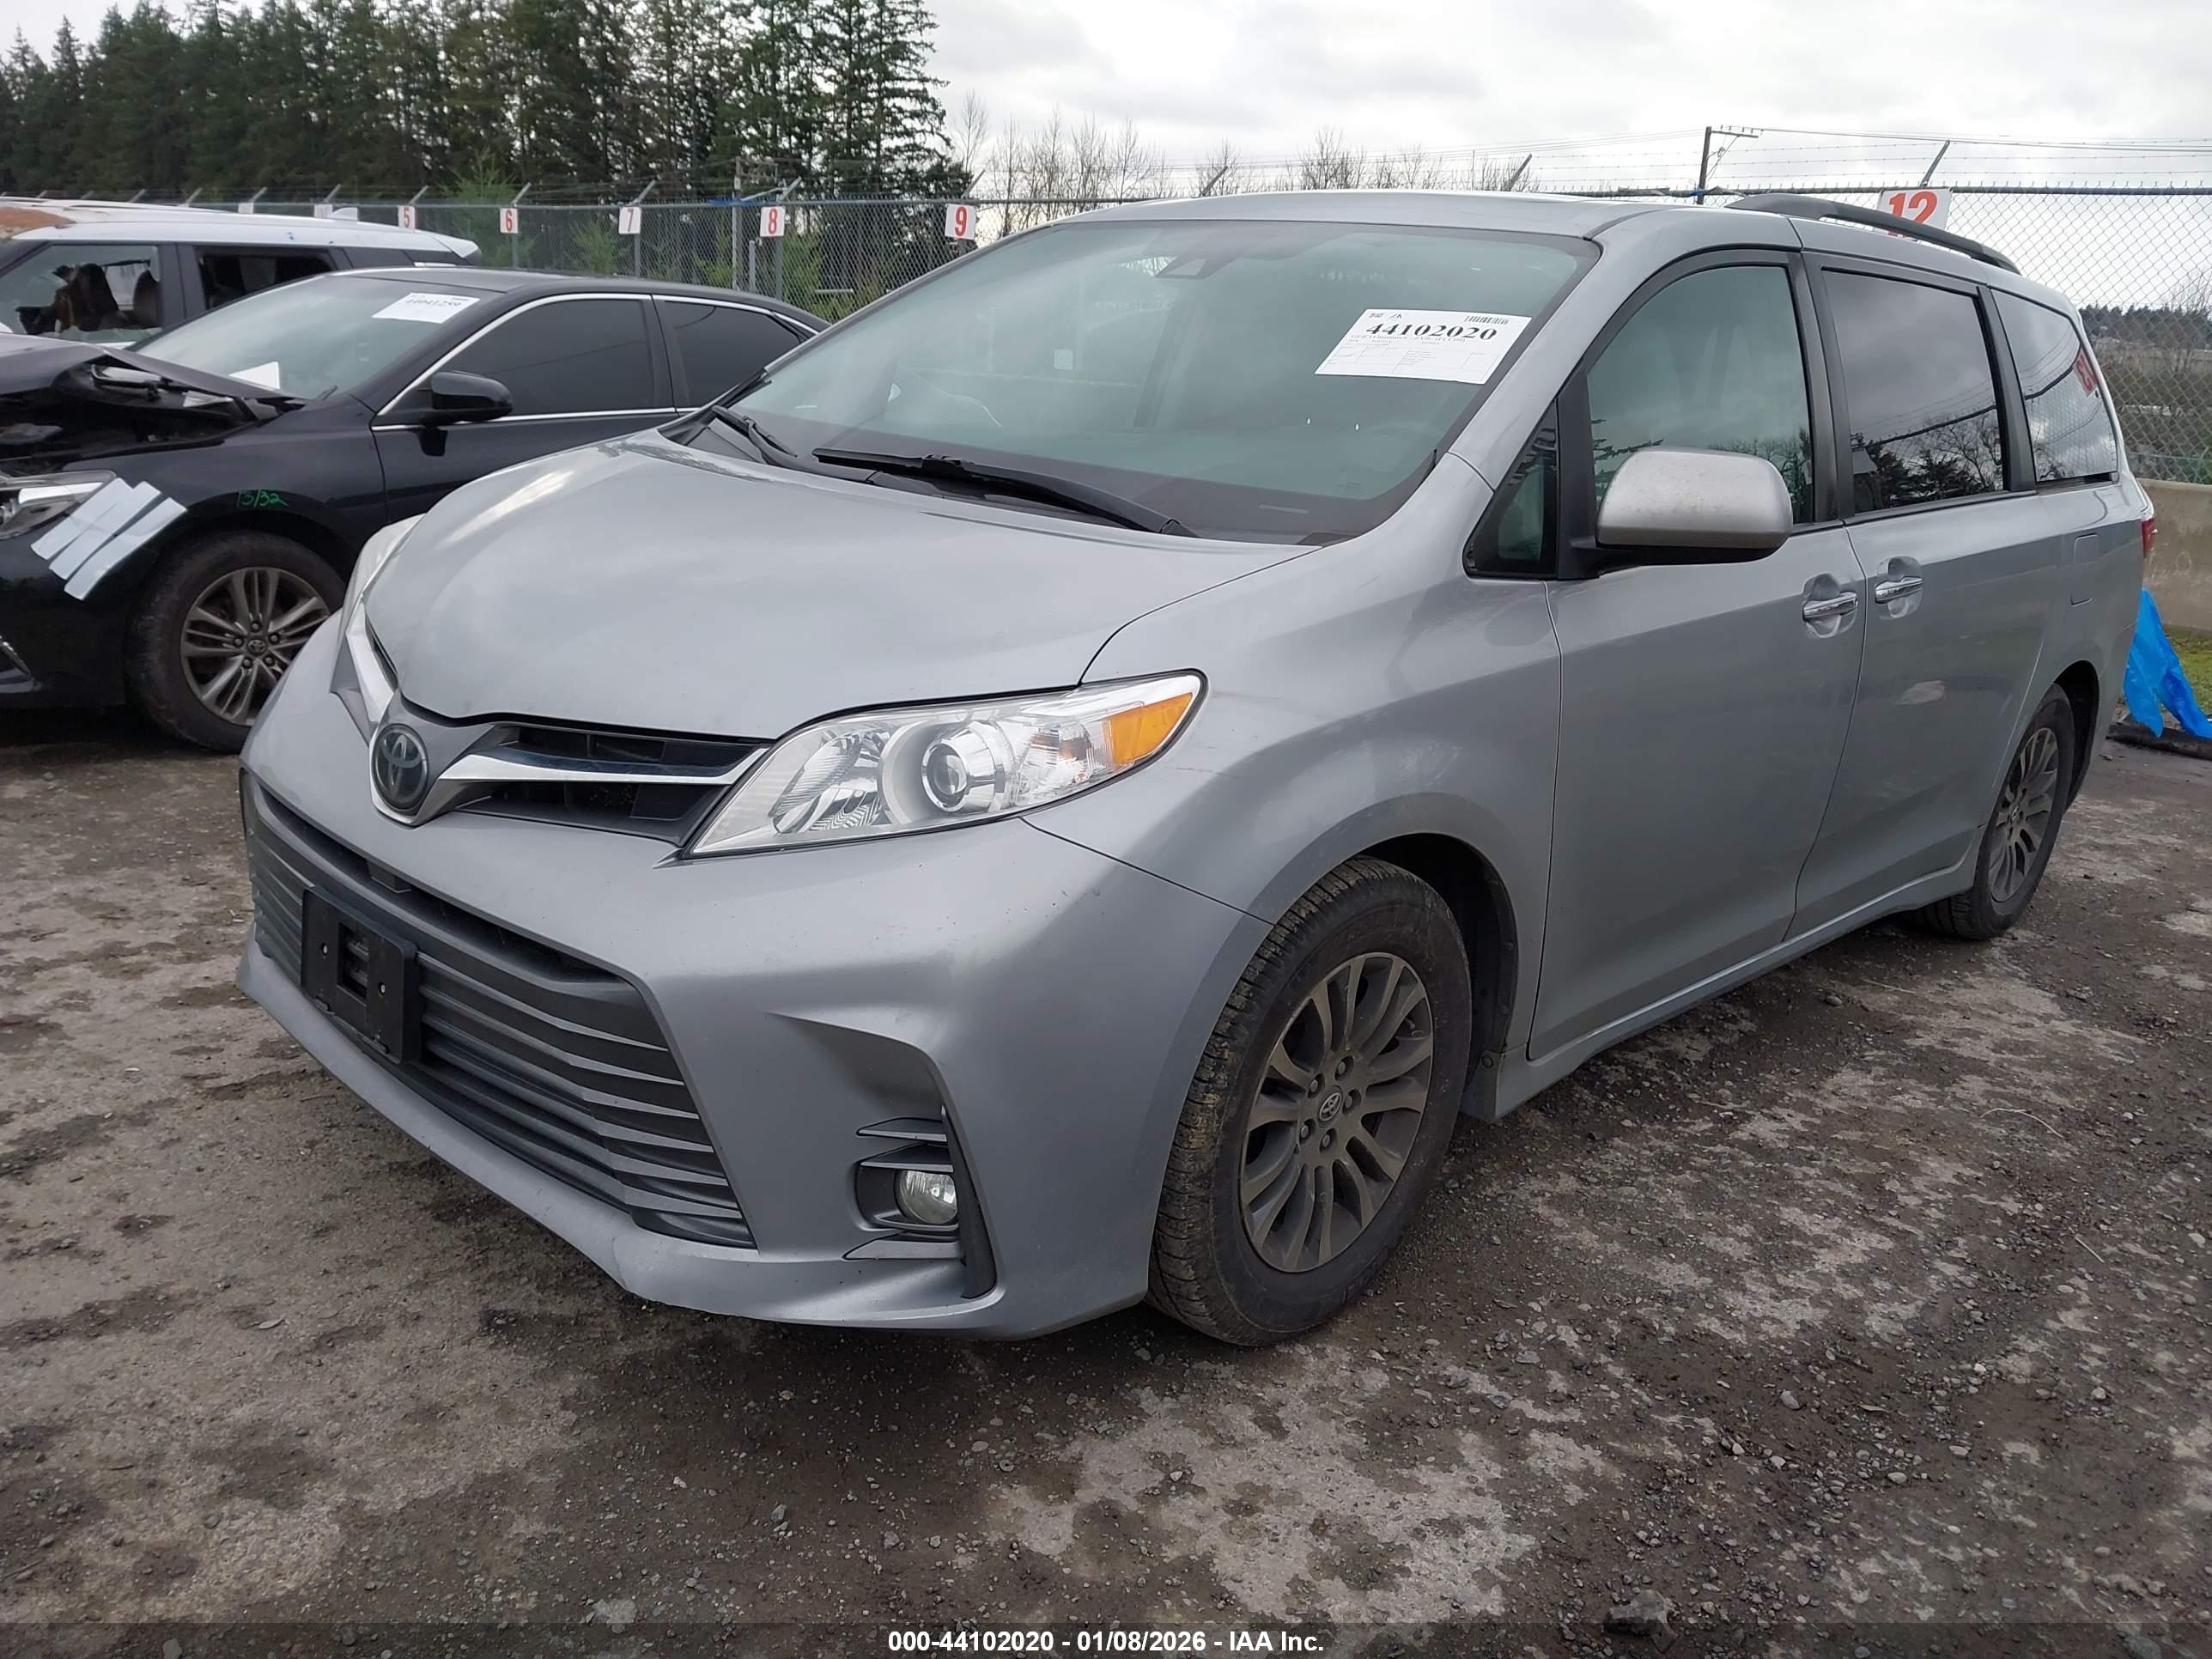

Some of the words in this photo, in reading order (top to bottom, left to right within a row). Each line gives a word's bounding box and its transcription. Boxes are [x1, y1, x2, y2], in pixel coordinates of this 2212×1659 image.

[404, 207, 410, 228] 5
[1889, 191, 1937, 225] 12
[506, 210, 513, 232] 6
[628, 209, 635, 232] 7
[769, 209, 777, 234] 8
[955, 206, 967, 237] 9
[1366, 323, 1497, 340] 44102020
